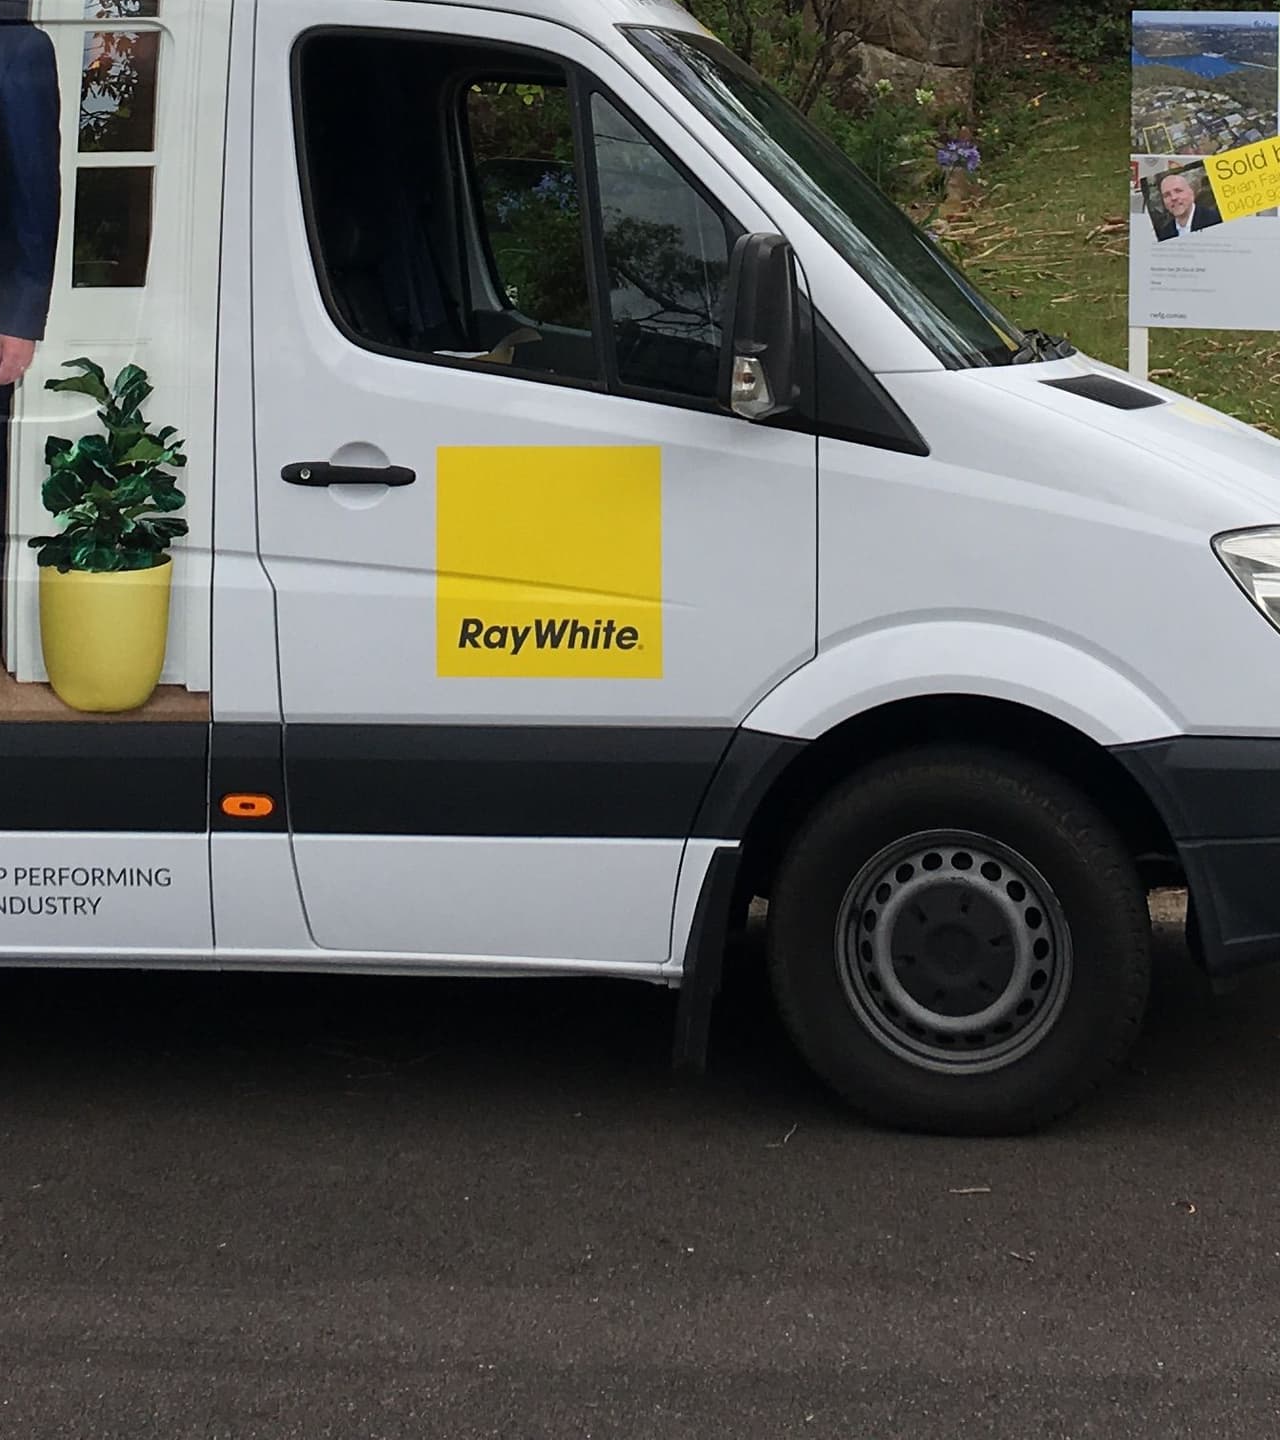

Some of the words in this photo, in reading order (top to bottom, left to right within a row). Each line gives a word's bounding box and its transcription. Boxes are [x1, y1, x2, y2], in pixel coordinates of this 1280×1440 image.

[1215, 148, 1268, 181] Sold
[1227, 193, 1263, 215] 0402
[458, 618, 640, 656] RayWhite
[14, 866, 172, 888] PERFORMING
